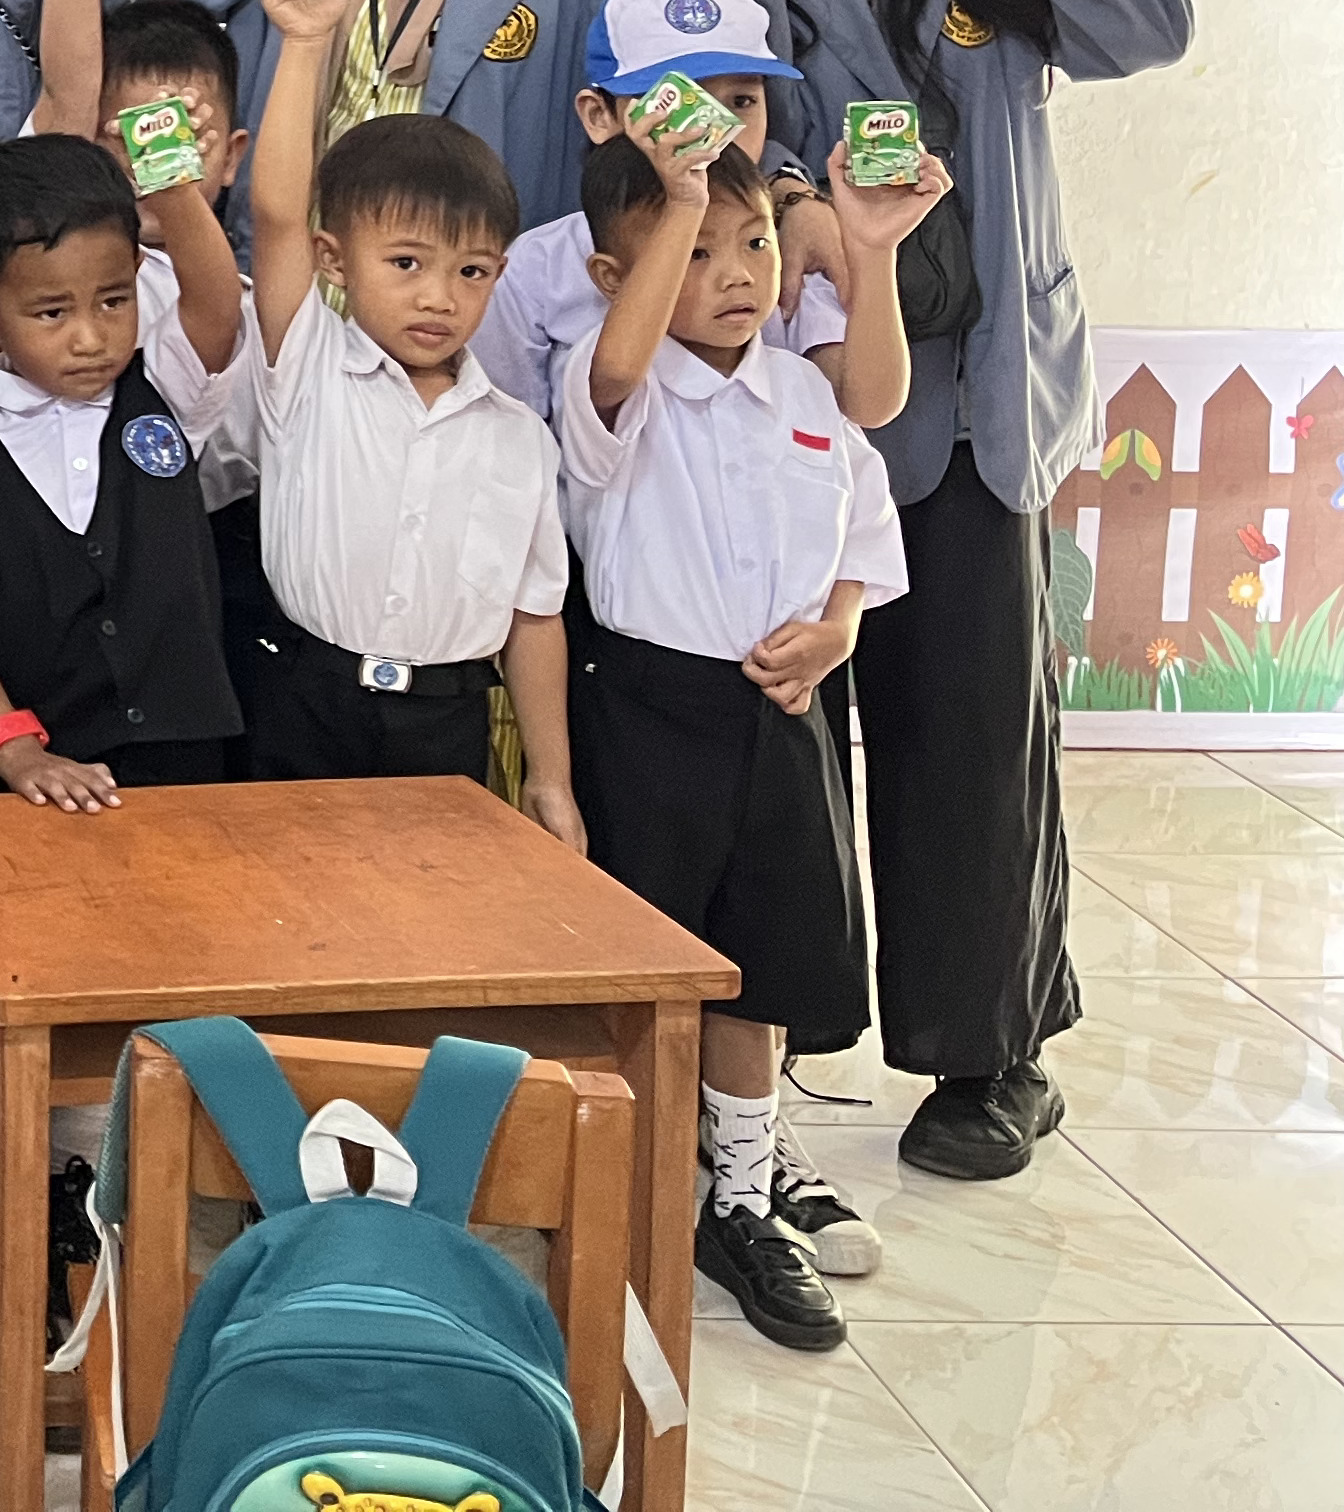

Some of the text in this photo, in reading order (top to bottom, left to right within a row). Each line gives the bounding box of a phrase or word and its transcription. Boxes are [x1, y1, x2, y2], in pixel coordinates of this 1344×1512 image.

[655, 90, 676, 110] ILO
[139, 116, 174, 137] MILO
[867, 118, 904, 131] MILO
